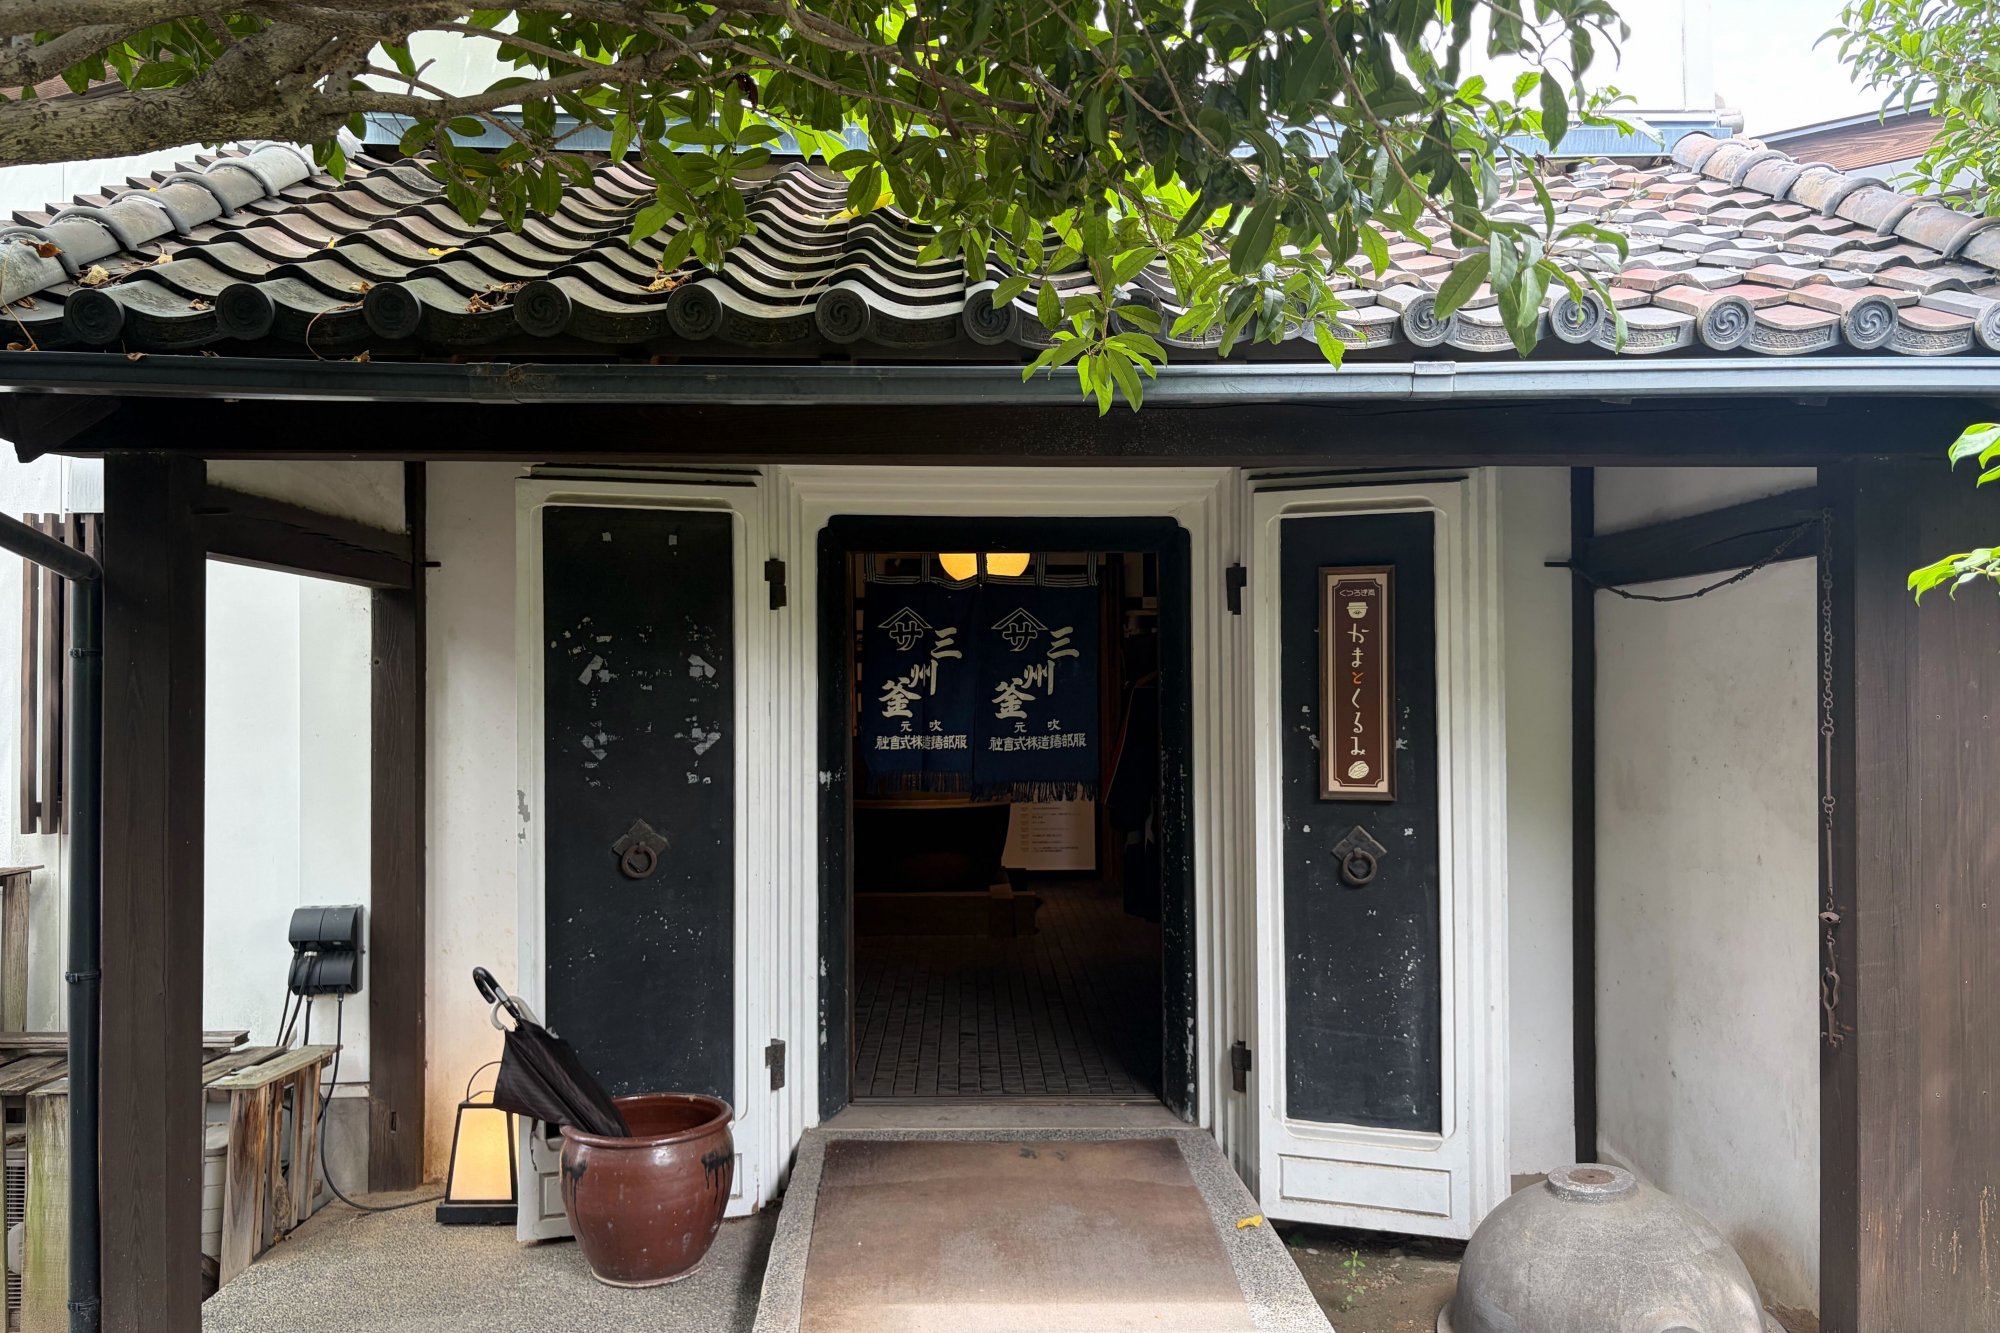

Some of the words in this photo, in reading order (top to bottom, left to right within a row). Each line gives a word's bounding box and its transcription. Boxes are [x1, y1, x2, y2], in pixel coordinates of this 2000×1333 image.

[878, 626, 963, 718] 三州釜
[991, 626, 1080, 719] 三州釜
[1347, 623, 1370, 755] かまとくるみ
